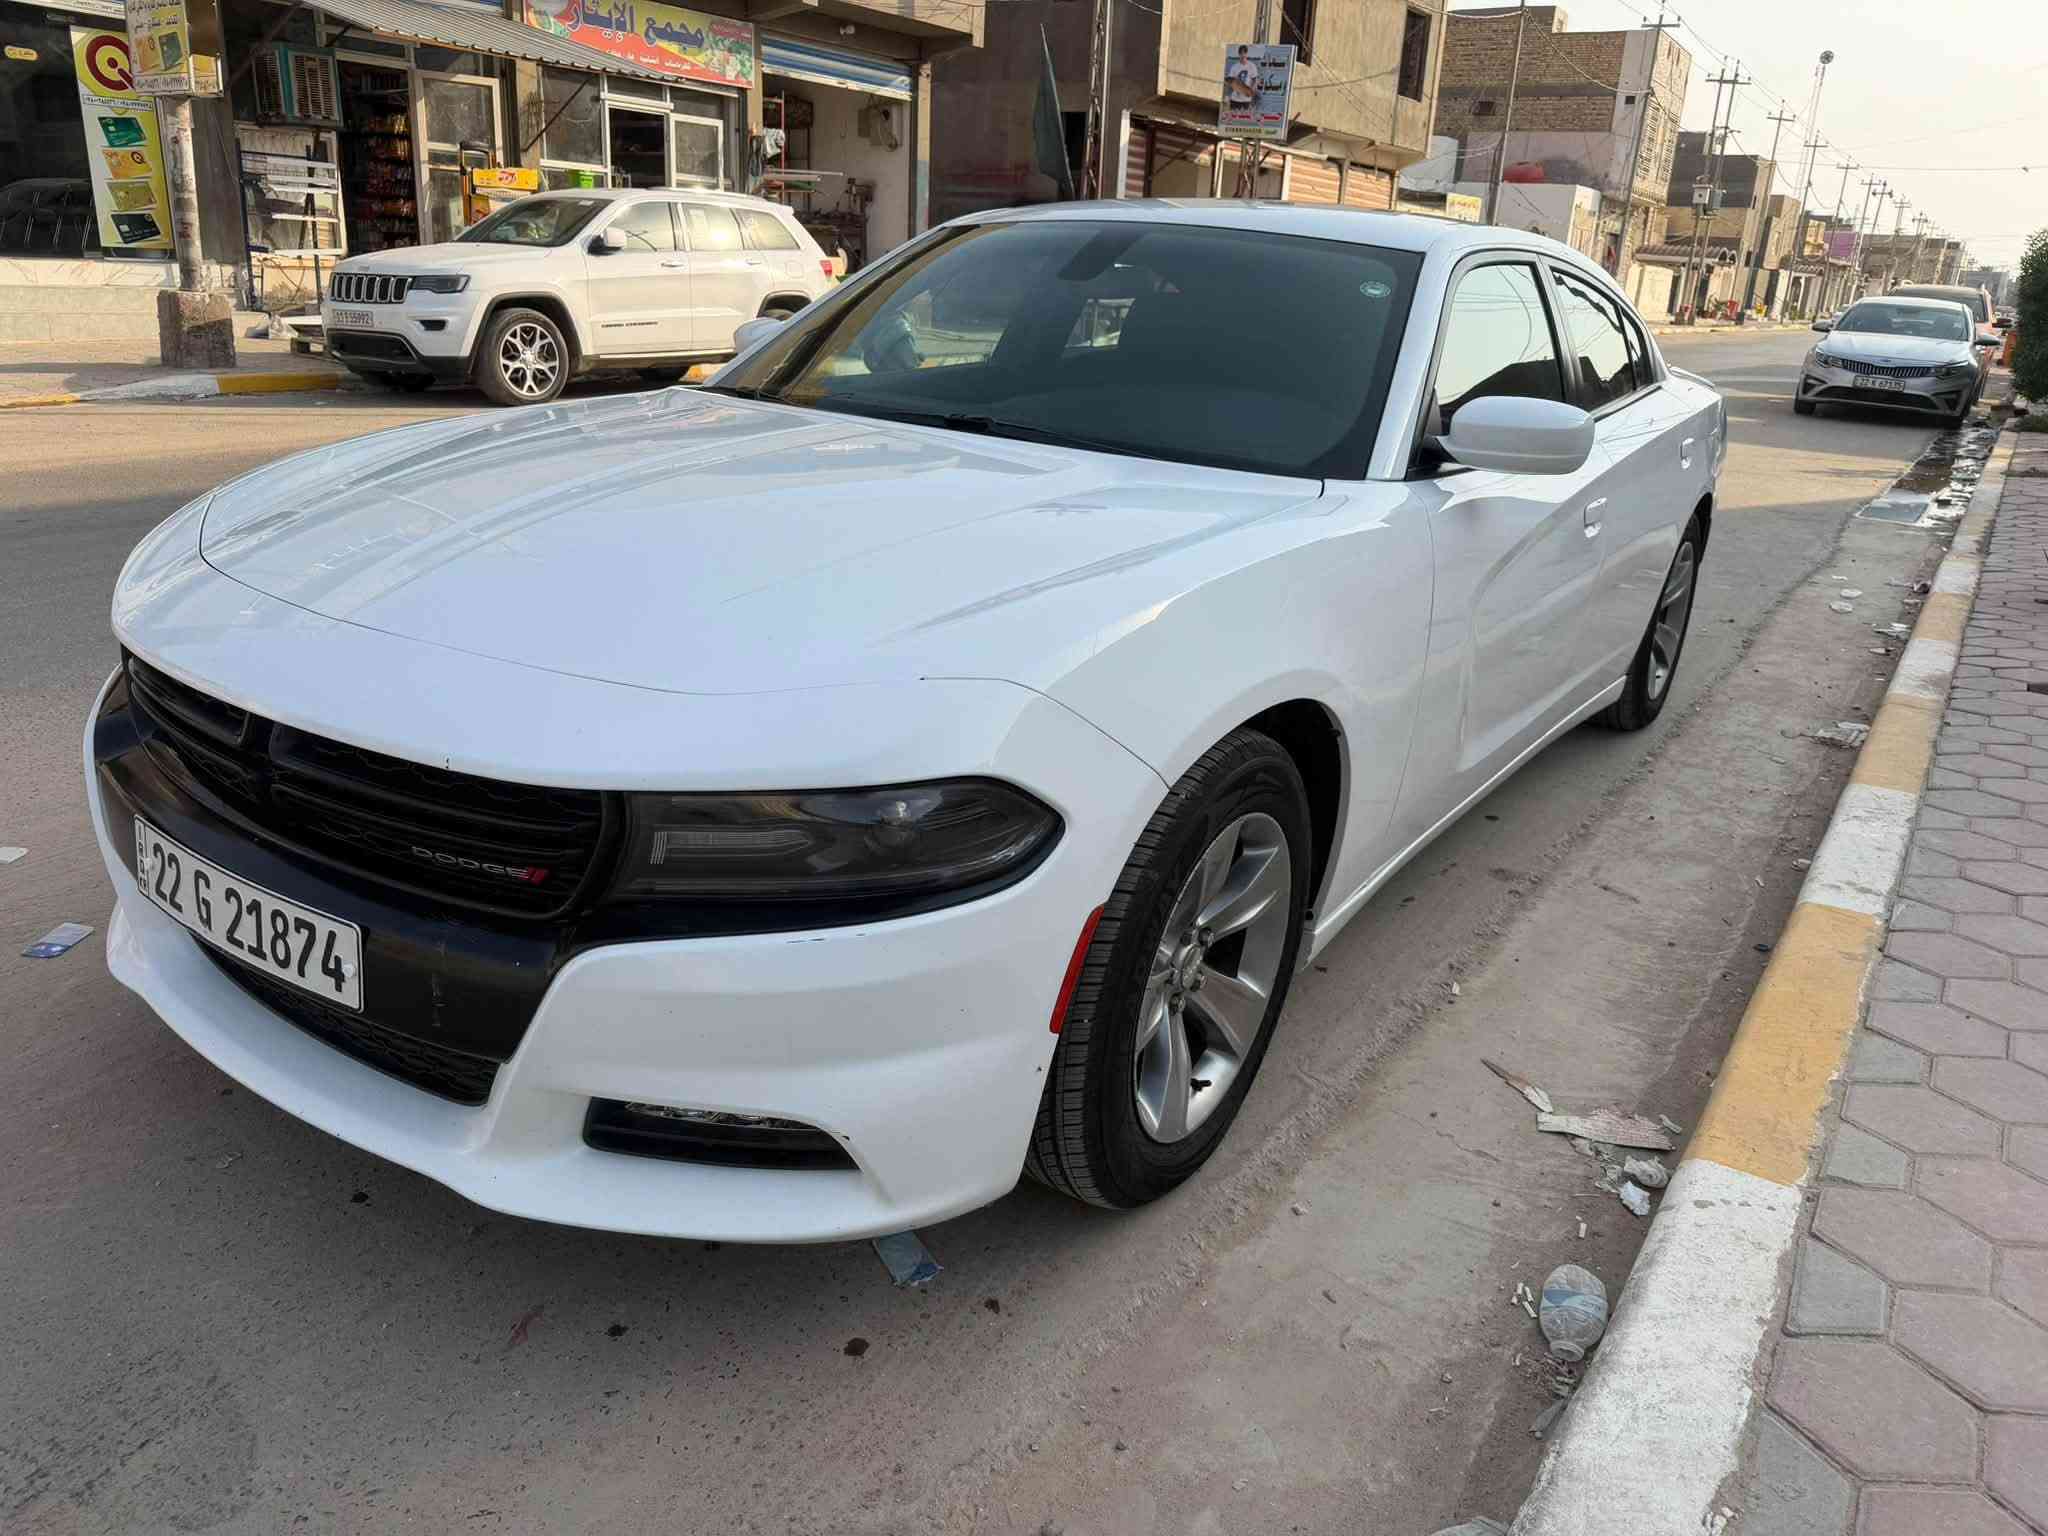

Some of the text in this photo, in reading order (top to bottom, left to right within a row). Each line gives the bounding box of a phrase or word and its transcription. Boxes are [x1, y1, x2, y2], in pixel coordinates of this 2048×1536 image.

[644, 17, 705, 51] مجمع
[411, 846, 529, 879] DODGE
[152, 842, 346, 993] 22 G 21874
